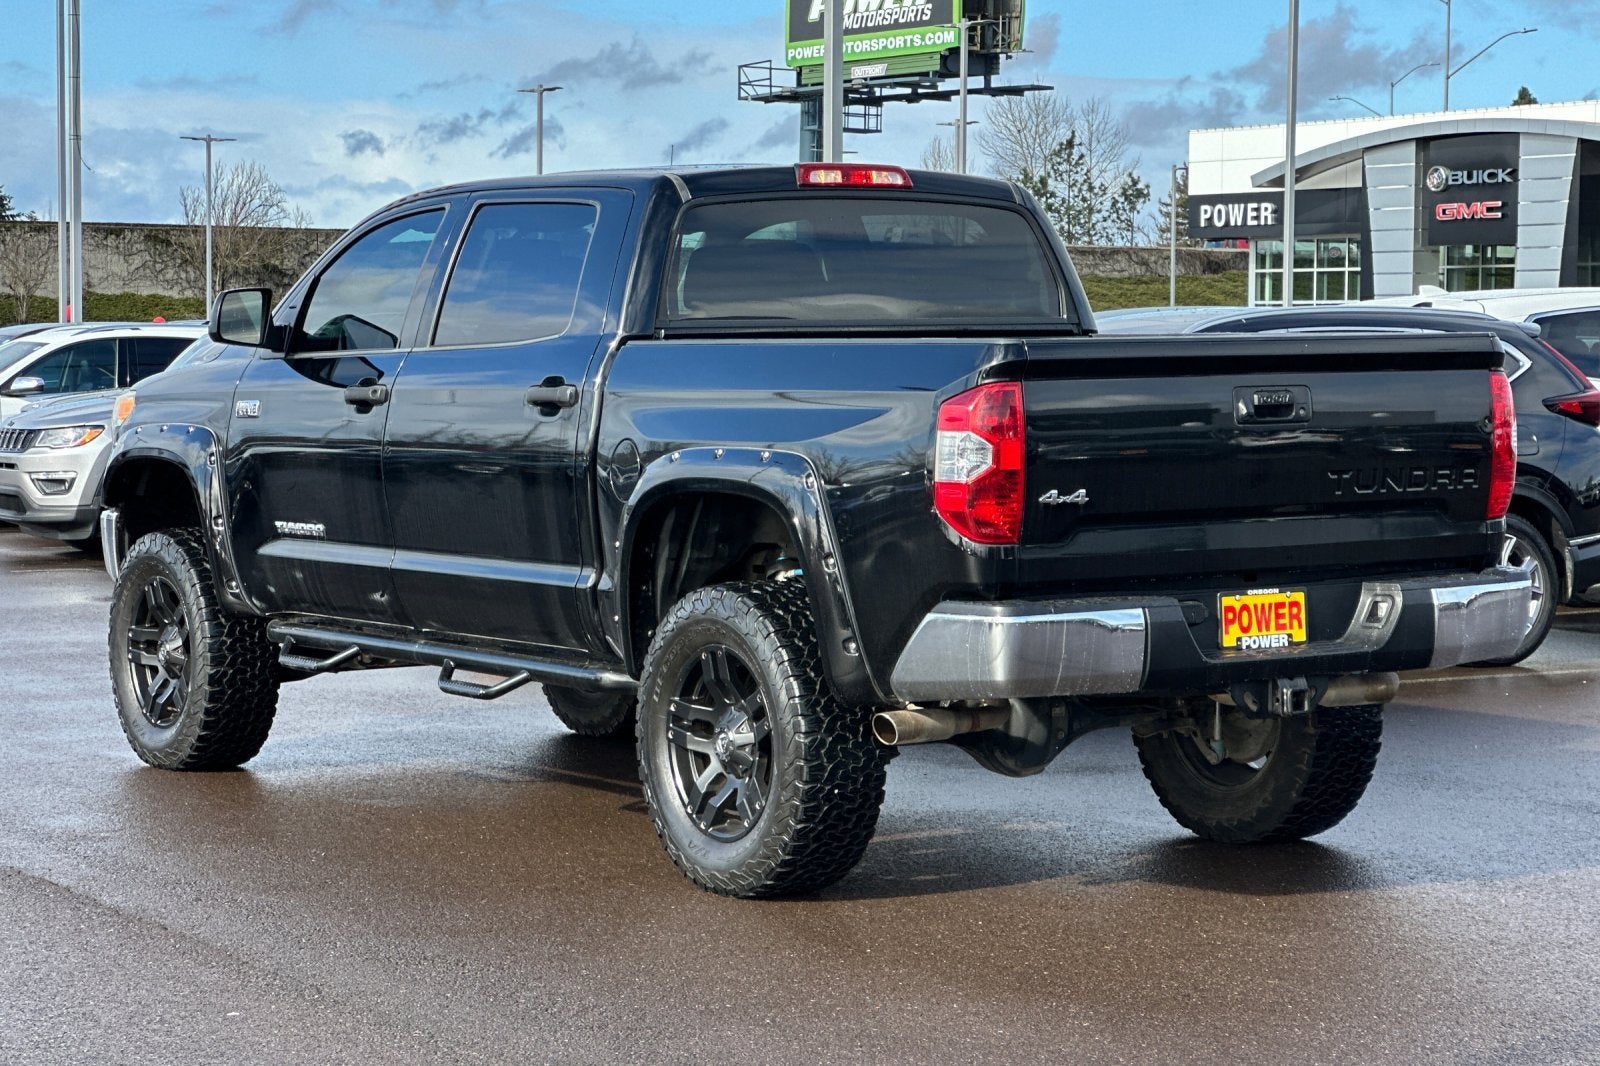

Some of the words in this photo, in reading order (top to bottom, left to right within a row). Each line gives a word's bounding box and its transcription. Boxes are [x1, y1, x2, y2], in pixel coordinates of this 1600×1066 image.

[843, 3, 933, 30] MOTORSPORTS
[1447, 168, 1513, 185] BUICK
[1199, 203, 1275, 228] POWER
[1436, 201, 1502, 220] GMC
[1327, 467, 1480, 496] TUNDRA
[1038, 488, 1090, 505] 4x4
[1246, 588, 1280, 596] OREGON
[1223, 600, 1303, 636] POWER
[1241, 633, 1288, 650] POWER
